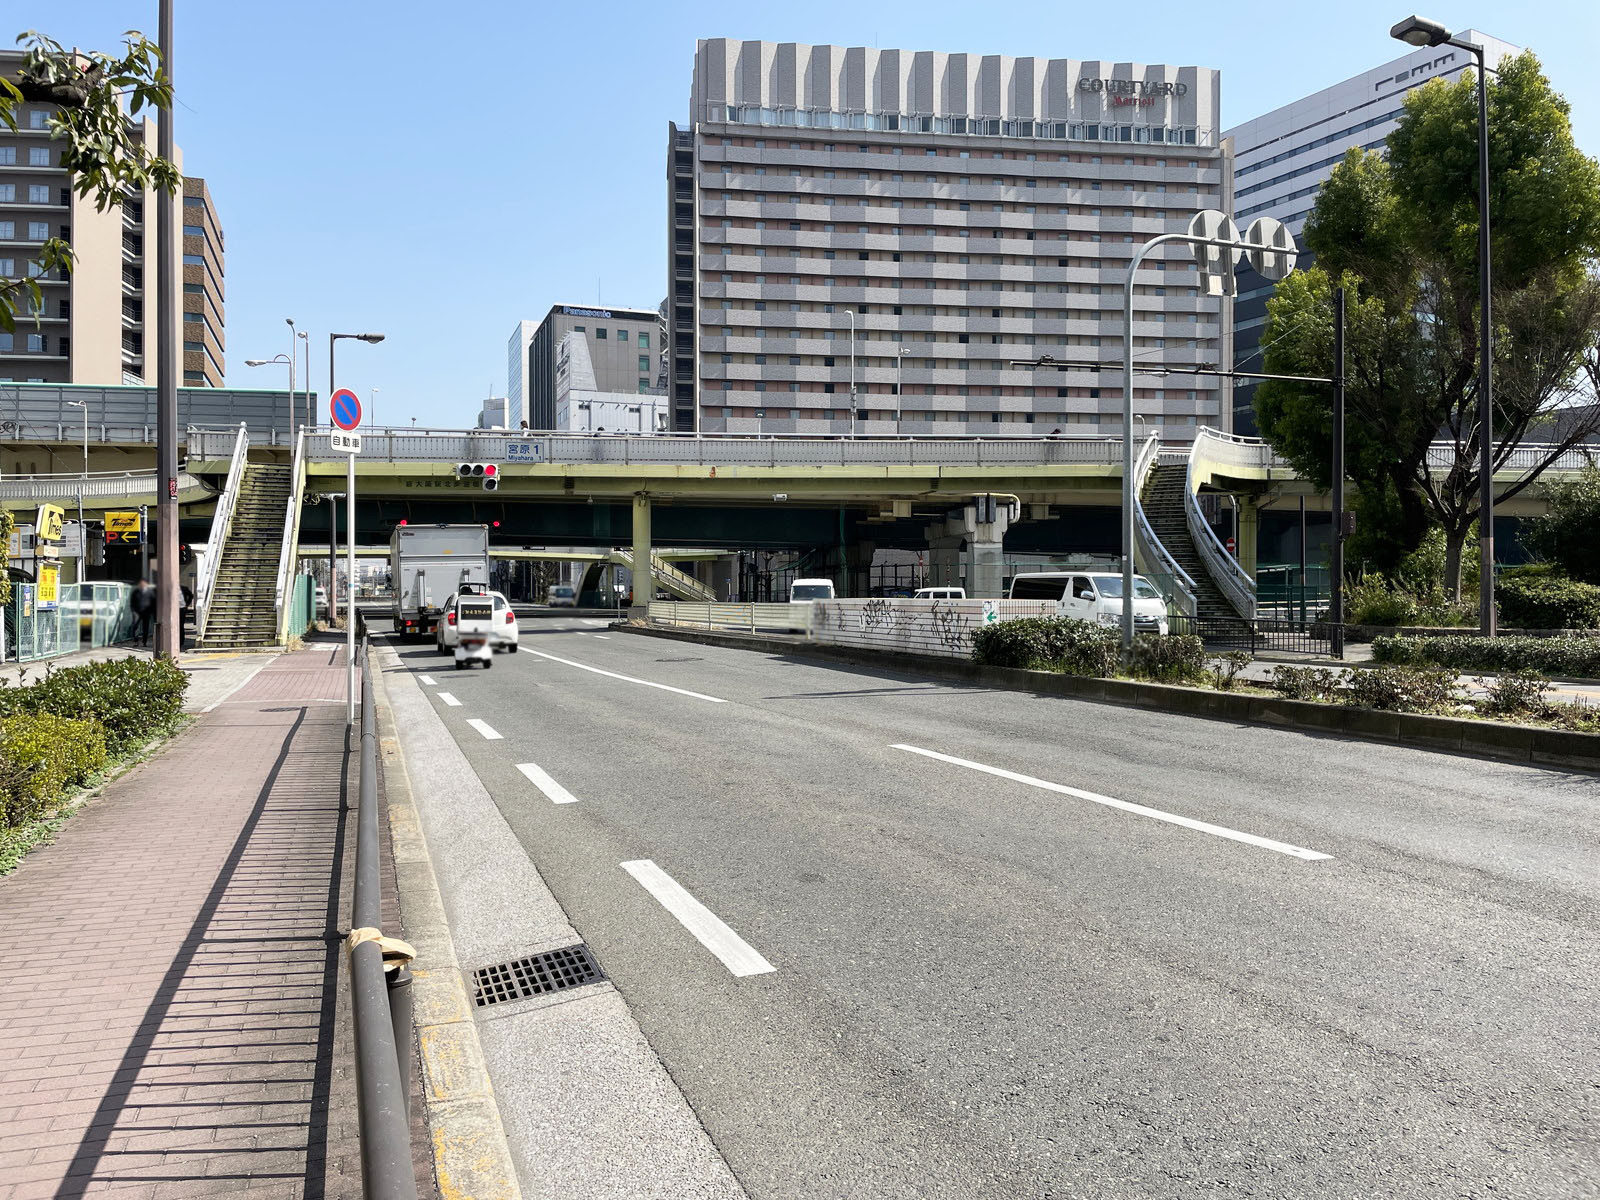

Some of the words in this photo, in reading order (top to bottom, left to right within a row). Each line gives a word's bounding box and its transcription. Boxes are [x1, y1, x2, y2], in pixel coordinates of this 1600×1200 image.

[1078, 77, 1188, 97] COURTYARD
[1111, 95, 1155, 108] Marriott
[563, 306, 611, 318] Panasonic
[332, 435, 360, 448] 自動車
[508, 444, 530, 455] 宮原
[533, 444, 539, 455] 1
[508, 454, 534, 462] Miyahara
[111, 518, 136, 527] Times
[105, 531, 119, 544] P
